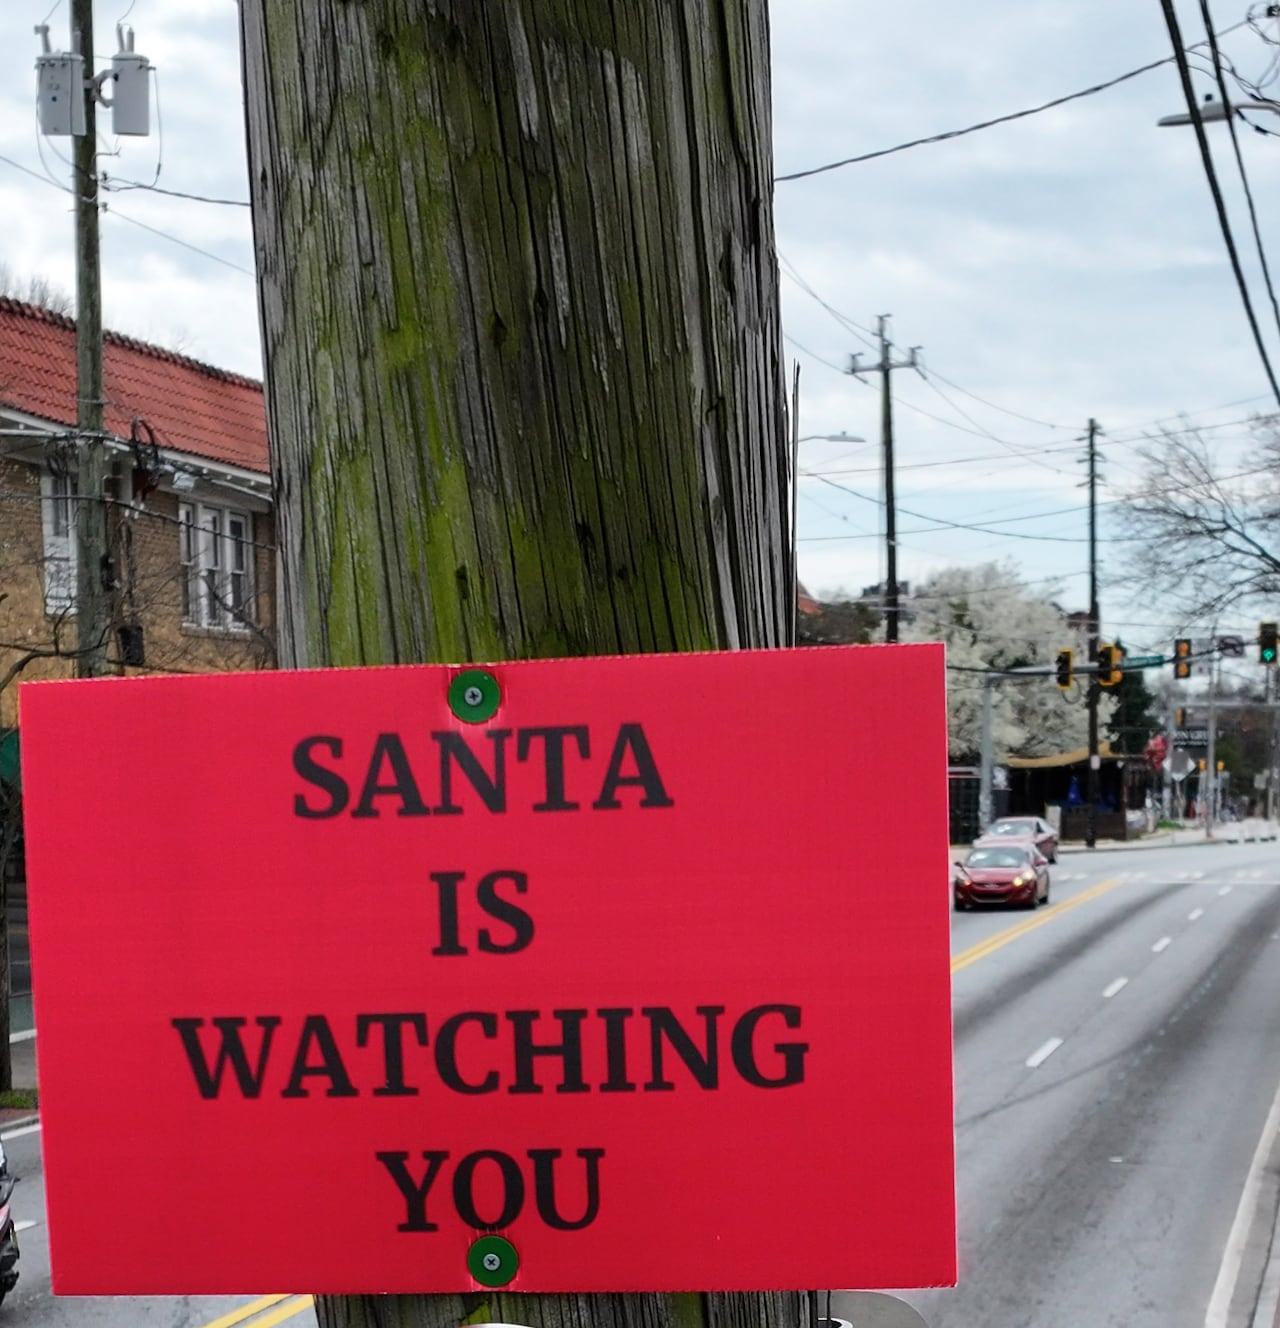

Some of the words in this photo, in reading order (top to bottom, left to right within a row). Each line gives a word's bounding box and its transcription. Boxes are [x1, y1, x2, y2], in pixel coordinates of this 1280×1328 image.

[293, 722, 674, 820] SANTA
[430, 870, 535, 956] IS
[171, 1004, 809, 1100] WATCHING
[376, 1148, 605, 1233] YOU
